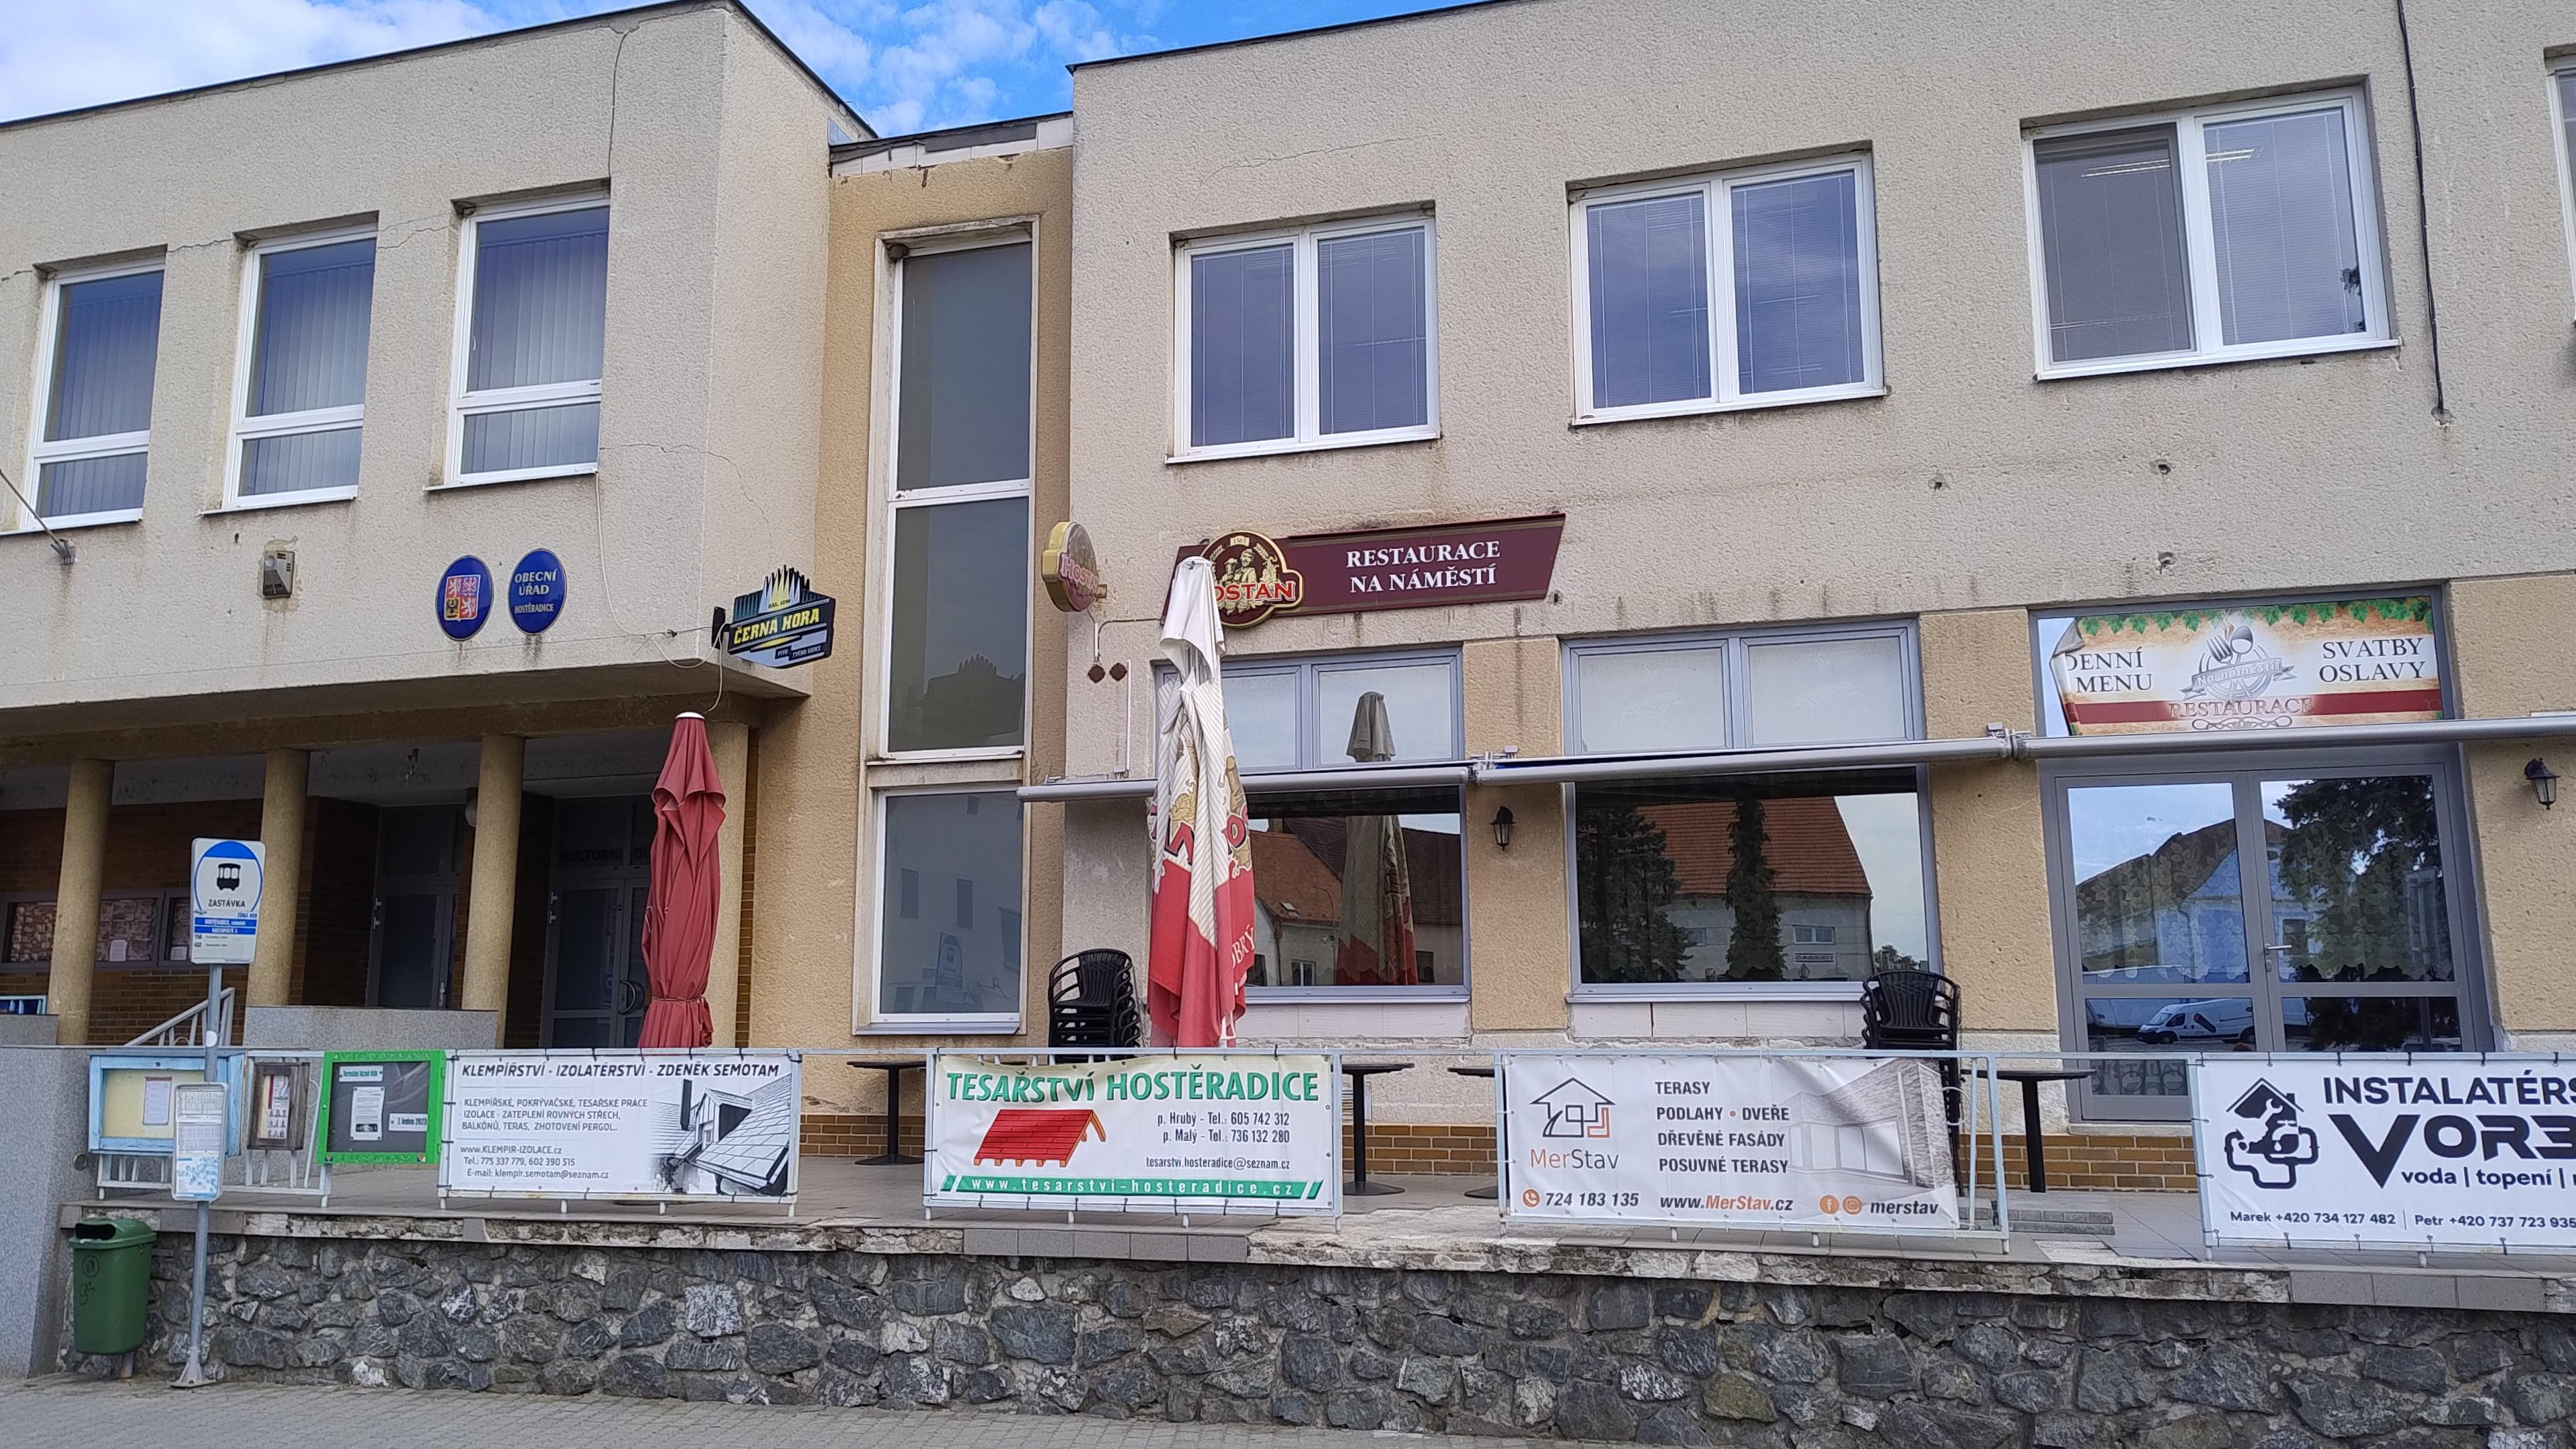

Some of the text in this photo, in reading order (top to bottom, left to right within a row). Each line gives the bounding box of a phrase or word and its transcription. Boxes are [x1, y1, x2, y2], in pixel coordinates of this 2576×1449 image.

[1346, 540, 1501, 568] RESTAURACE
[515, 568, 558, 583] OBECNÍ
[1350, 563, 1497, 593] NA NÁMĚSTÍ
[519, 583, 550, 596] ÚŘAD
[1214, 581, 1297, 602] OSTAN
[515, 603, 554, 614] HOSTĚRADICE
[734, 608, 819, 644] ČERNÁ HORA
[2322, 637, 2423, 659] SVATBY
[2066, 646, 2144, 671] DENNÍ
[2319, 661, 2426, 682] OSLAVY
[2075, 674, 2152, 693] MENU
[2197, 675, 2215, 686] Na
[2168, 698, 2314, 717] RESTAURACE
[560, 845, 622, 861] KULTURNÍ
[209, 898, 246, 907] ZASTÁVKA
[462, 1062, 547, 1076] KLEMPÍŘSTVÍ
[556, 1062, 646, 1076] IZOLATÉRSTVÍ
[656, 1062, 711, 1076] ZDENĚK
[713, 1064, 780, 1076] SEMOTAM
[947, 1064, 1319, 1103] TESAŘSTVÍ HOSTĚRADICE
[1655, 1082, 1710, 1094] TERASY
[464, 1097, 648, 1109] KLEMPÍŘSKÉ, POKRÝVAČSKÉ, TESAŘSKÉ PRÁCE
[463, 1110, 496, 1119] IZOLACE
[502, 1109, 545, 1119] ZATEPLENÍ
[546, 1109, 585, 1119] ROVNÝCH
[587, 1109, 620, 1120] STŘECH,
[1158, 1114, 1166, 1127] p.
[1170, 1112, 1197, 1127] Hrubý
[1207, 1112, 1227, 1125] Tel.:
[1231, 1112, 1249, 1125] 605
[1253, 1112, 1271, 1125] 742
[1274, 1113, 1289, 1126] 312
[1657, 1105, 1790, 1121] PODLAHY DVEŘE
[462, 1121, 500, 1131] BALKÓNŮ,
[504, 1122, 530, 1131] TERAS,
[533, 1122, 580, 1131] ZHOTOVENÍ
[1163, 1131, 1172, 1144] p.
[1175, 1129, 1197, 1144] Malý
[1208, 1129, 1229, 1142] Tel.:
[1232, 1129, 1248, 1143] 736
[1252, 1129, 1268, 1143] 132
[1272, 1130, 1290, 1144] 280
[1658, 1129, 1785, 1147] DŘEVĚNÉ FASÁDY
[461, 1146, 562, 1154] www.KLEMPIR-IZOLACE.cz
[464, 1156, 575, 1166] Tel.: 775 337 779, 602 390 515
[1146, 1156, 1291, 1170] tesarstvi.hosteradice@seznam.cz
[1530, 1148, 1619, 1169] MerStav
[1659, 1156, 1789, 1174] POSUVNÉ TERASY
[467, 1168, 609, 1180] E-mail: klempir.semotam@seznam.cz
[2401, 1168, 2456, 1185] voda
[2476, 1168, 2552, 1189] topení
[971, 1178, 1293, 1195] www.tesarstvi-hosteradice.cz
[1546, 1192, 1640, 1207] 724 183 135
[1660, 1195, 1794, 1211] www.MerStav.cz
[1870, 1199, 1939, 1215] merstav
[2230, 1211, 2396, 1224] Marek +420 734 127 482
[2415, 1214, 2576, 1228] Petr +420 737 723 935
